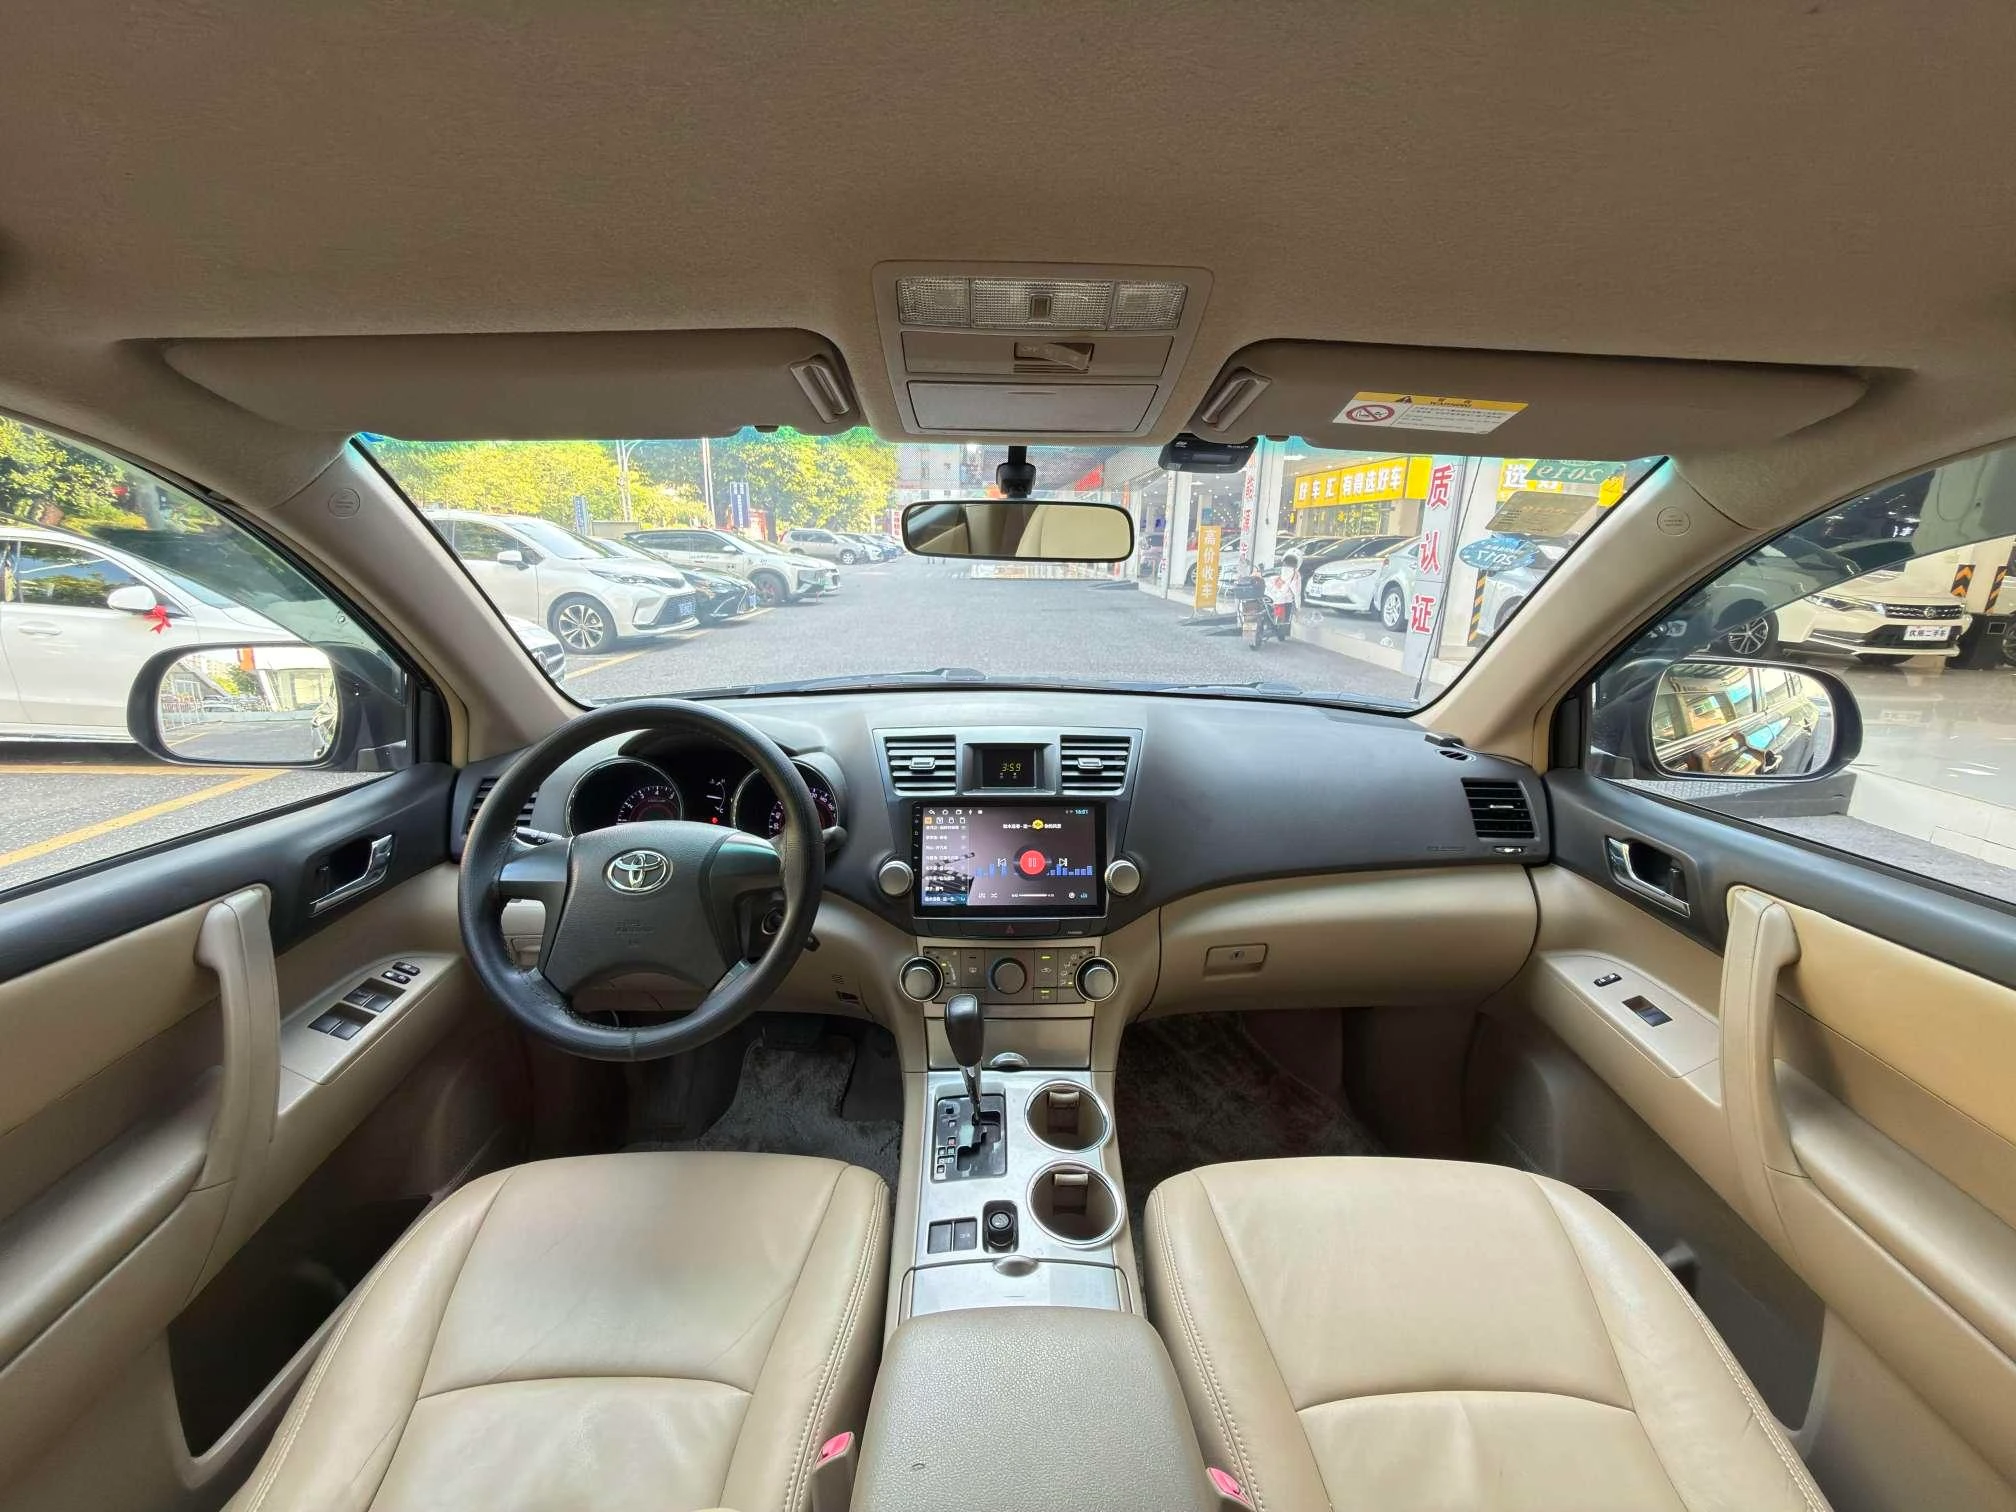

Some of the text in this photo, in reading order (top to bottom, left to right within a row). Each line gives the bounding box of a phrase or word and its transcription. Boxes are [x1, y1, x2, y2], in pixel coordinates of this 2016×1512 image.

[1298, 476, 1337, 501] 好车汇
[1342, 464, 1403, 497] 有得选好车
[1201, 528, 1217, 598] 高价收车
[1410, 463, 1455, 635] 质认证
[1001, 763, 1021, 772] 3:59
